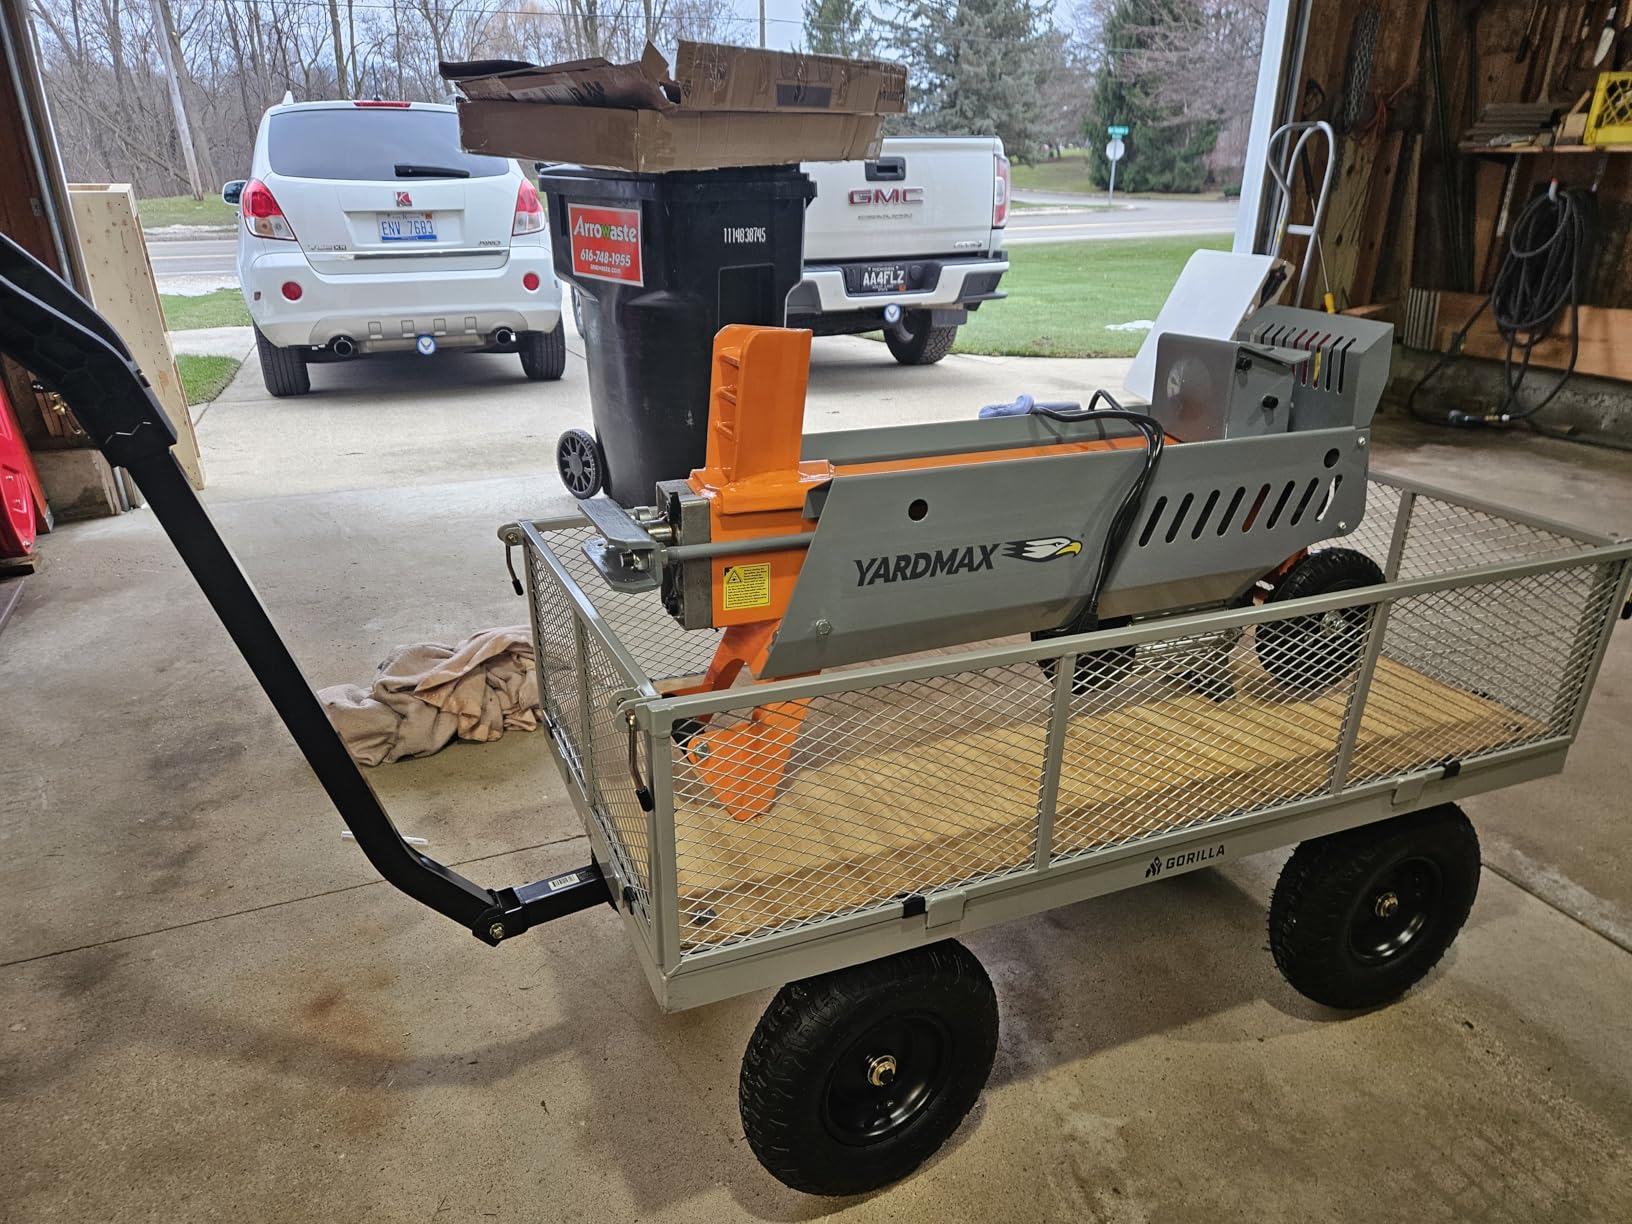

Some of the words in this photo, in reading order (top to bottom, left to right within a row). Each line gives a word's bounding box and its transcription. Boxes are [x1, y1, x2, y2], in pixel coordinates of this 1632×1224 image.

[849, 187, 923, 205] GMC
[573, 215, 637, 243] Arrowaste
[581, 248, 631, 267] 616-748-1955
[862, 270, 905, 287] AA4FLZ
[853, 543, 1001, 587] YARDMAX
[1165, 844, 1225, 870] GORILLA
